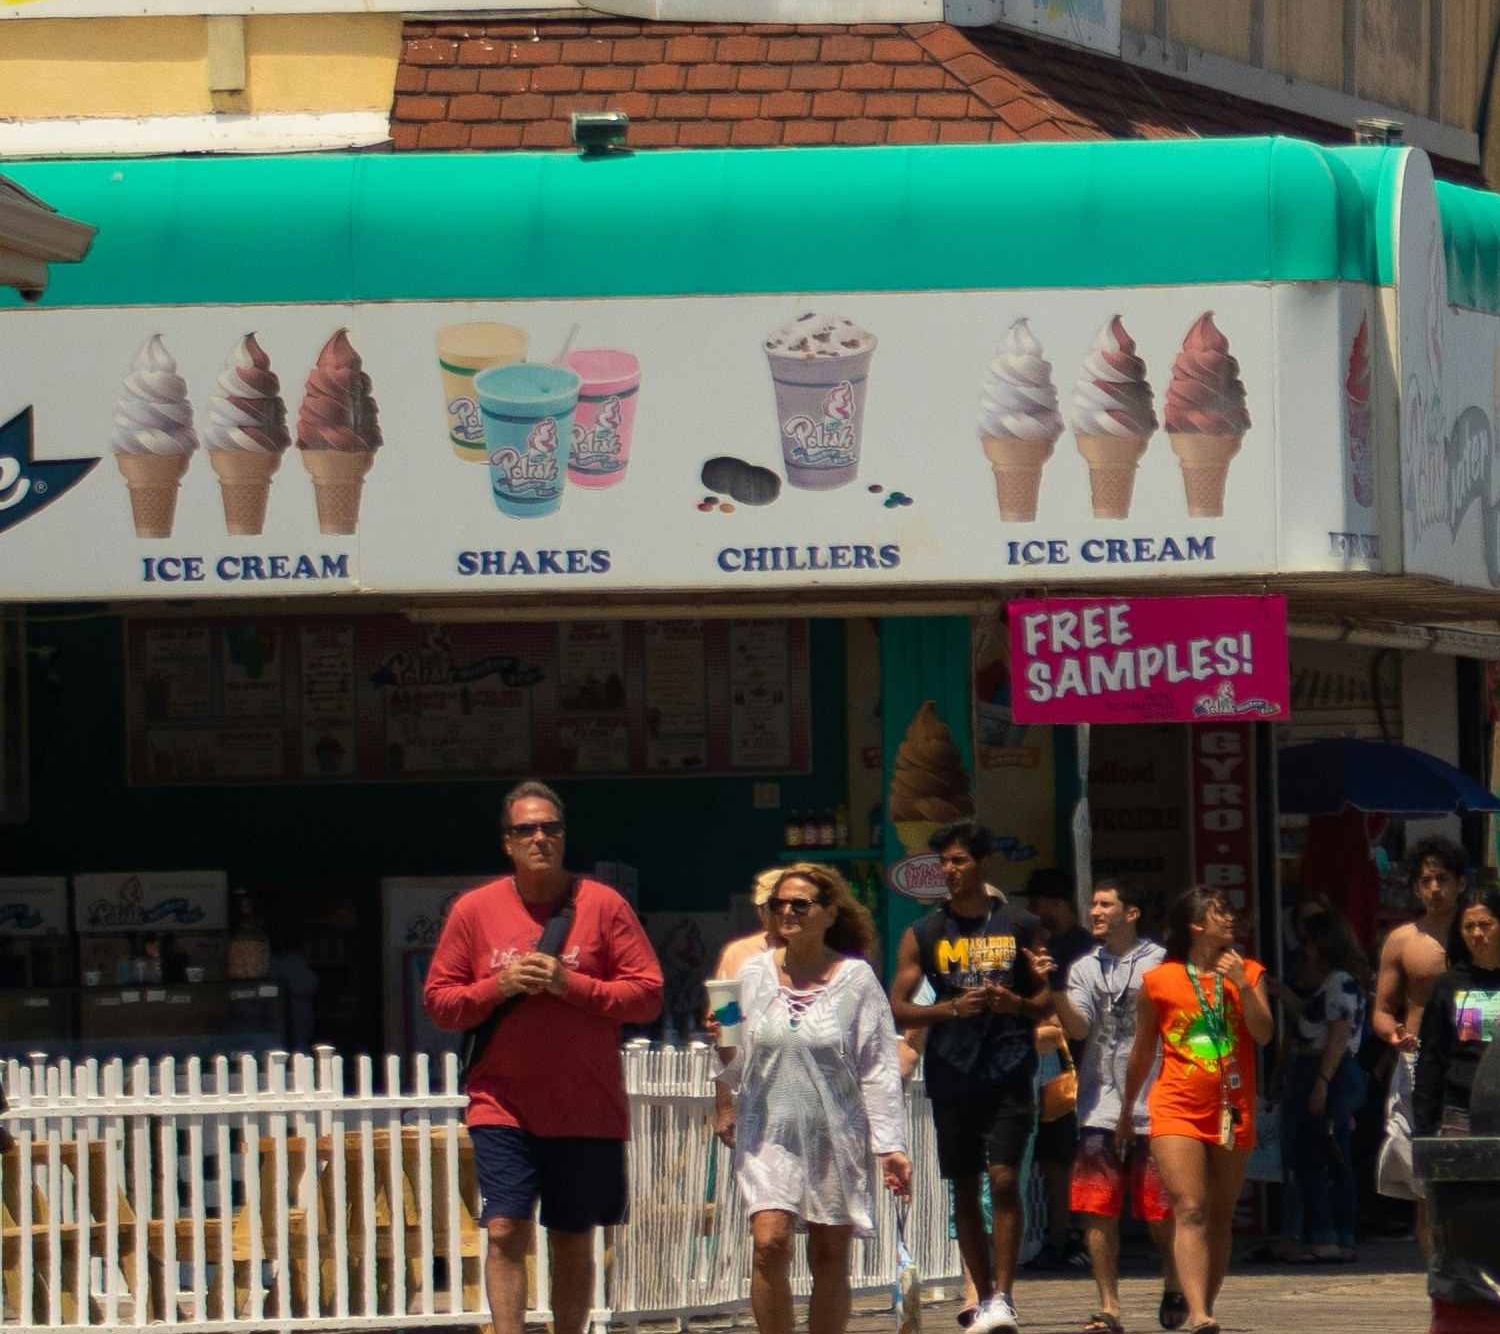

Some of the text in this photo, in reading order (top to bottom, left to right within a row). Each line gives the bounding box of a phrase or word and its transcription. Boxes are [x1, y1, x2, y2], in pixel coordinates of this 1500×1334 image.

[457, 548, 612, 577] SHAKES
[716, 543, 902, 573] CHILLERS
[1006, 535, 1217, 566] ICE CREAM
[142, 553, 350, 583] ICE CREAM
[1022, 603, 1132, 655] FREE
[1027, 633, 1254, 703] SAMPLES!
[1200, 731, 1245, 832] GYRO
